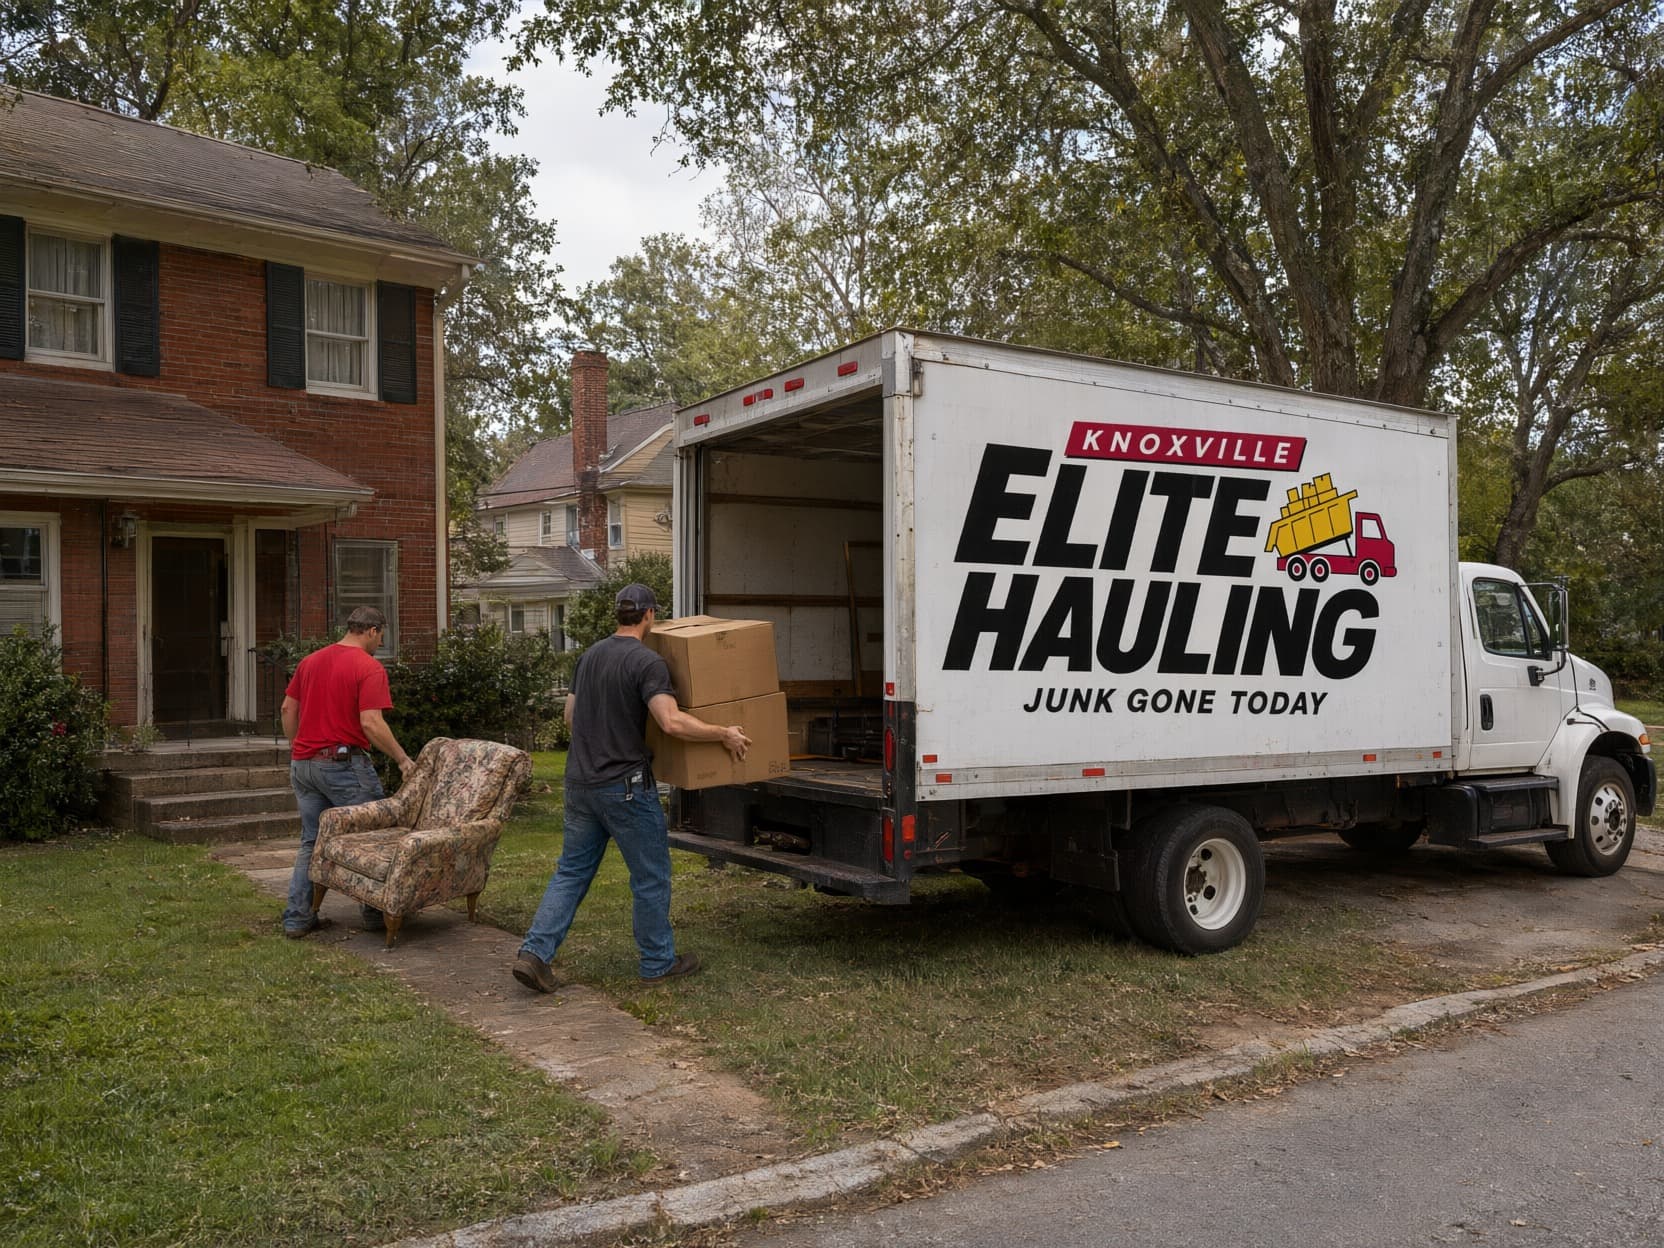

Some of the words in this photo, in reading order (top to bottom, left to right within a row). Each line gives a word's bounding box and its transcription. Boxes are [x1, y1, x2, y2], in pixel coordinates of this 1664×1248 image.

[1082, 429, 1292, 465] KNOXVILLE
[953, 442, 1272, 579] ELITE
[941, 571, 1380, 680] HAULING
[1023, 687, 1117, 713] JUNK
[1126, 688, 1217, 714] GONE
[1230, 690, 1329, 716] TODAY
